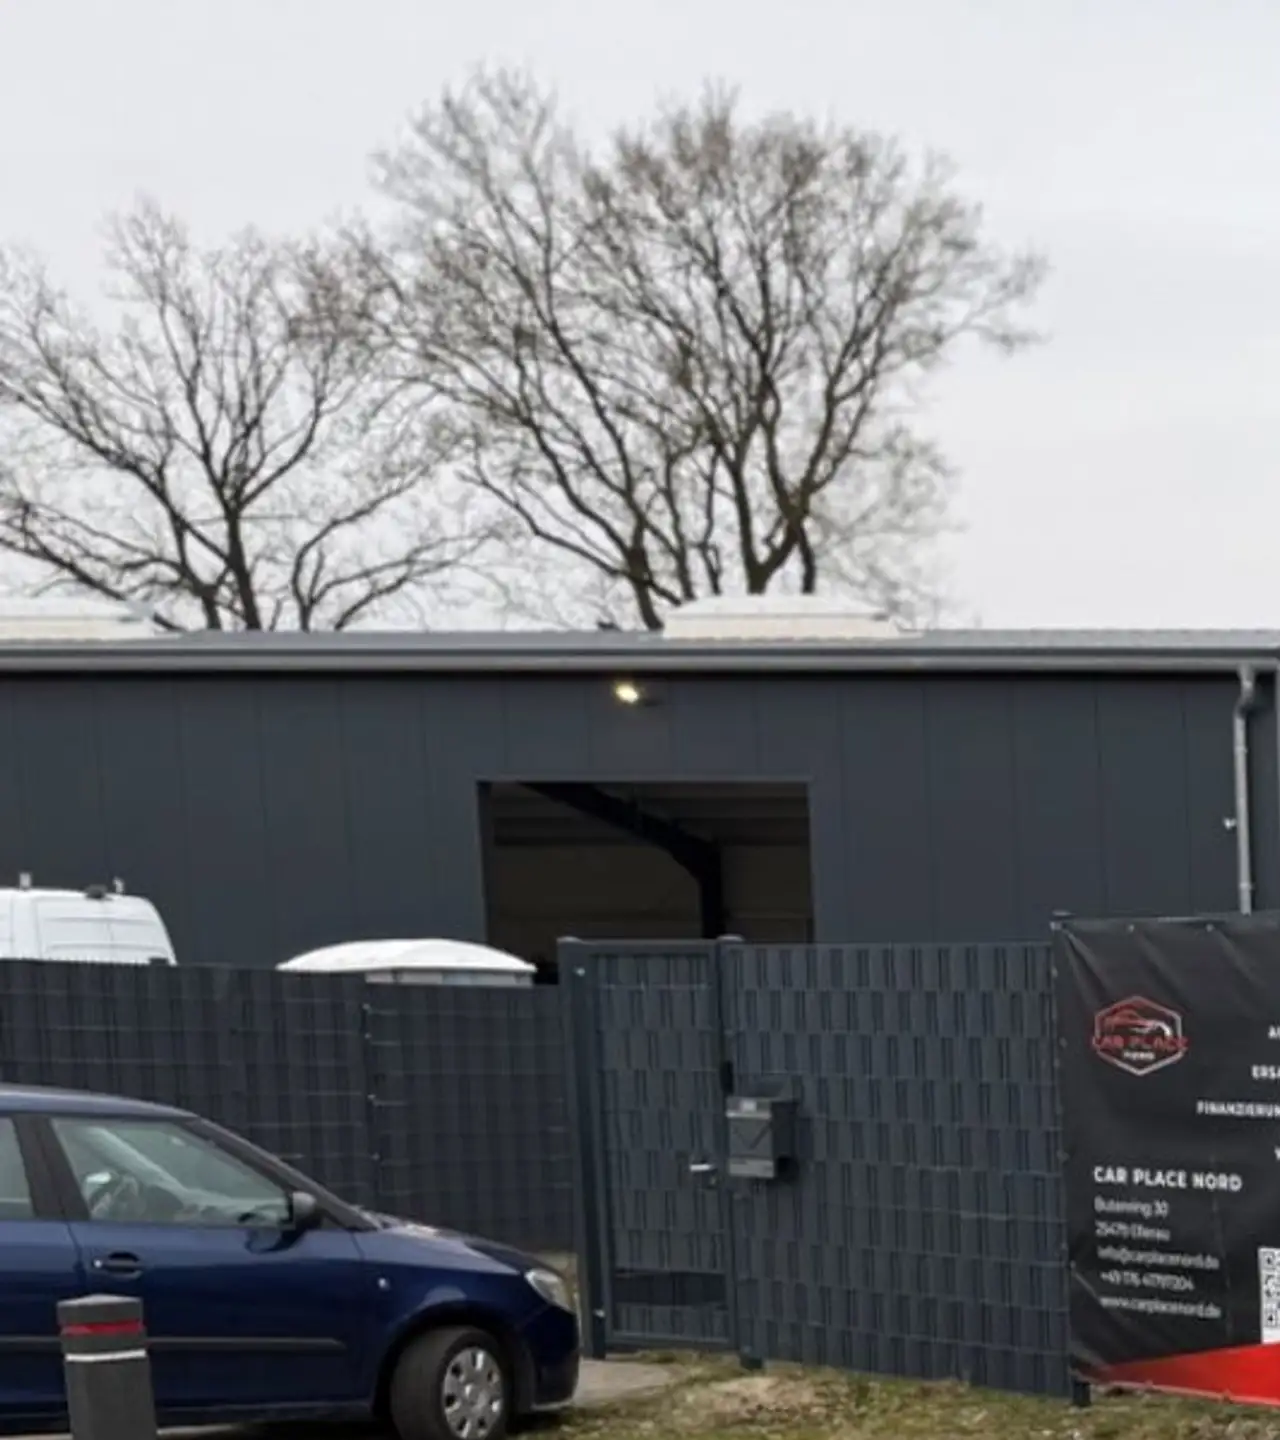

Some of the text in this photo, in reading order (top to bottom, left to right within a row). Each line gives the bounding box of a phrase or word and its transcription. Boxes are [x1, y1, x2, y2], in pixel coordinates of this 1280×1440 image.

[1093, 1166, 1243, 1192] CAR PLACE NORD
